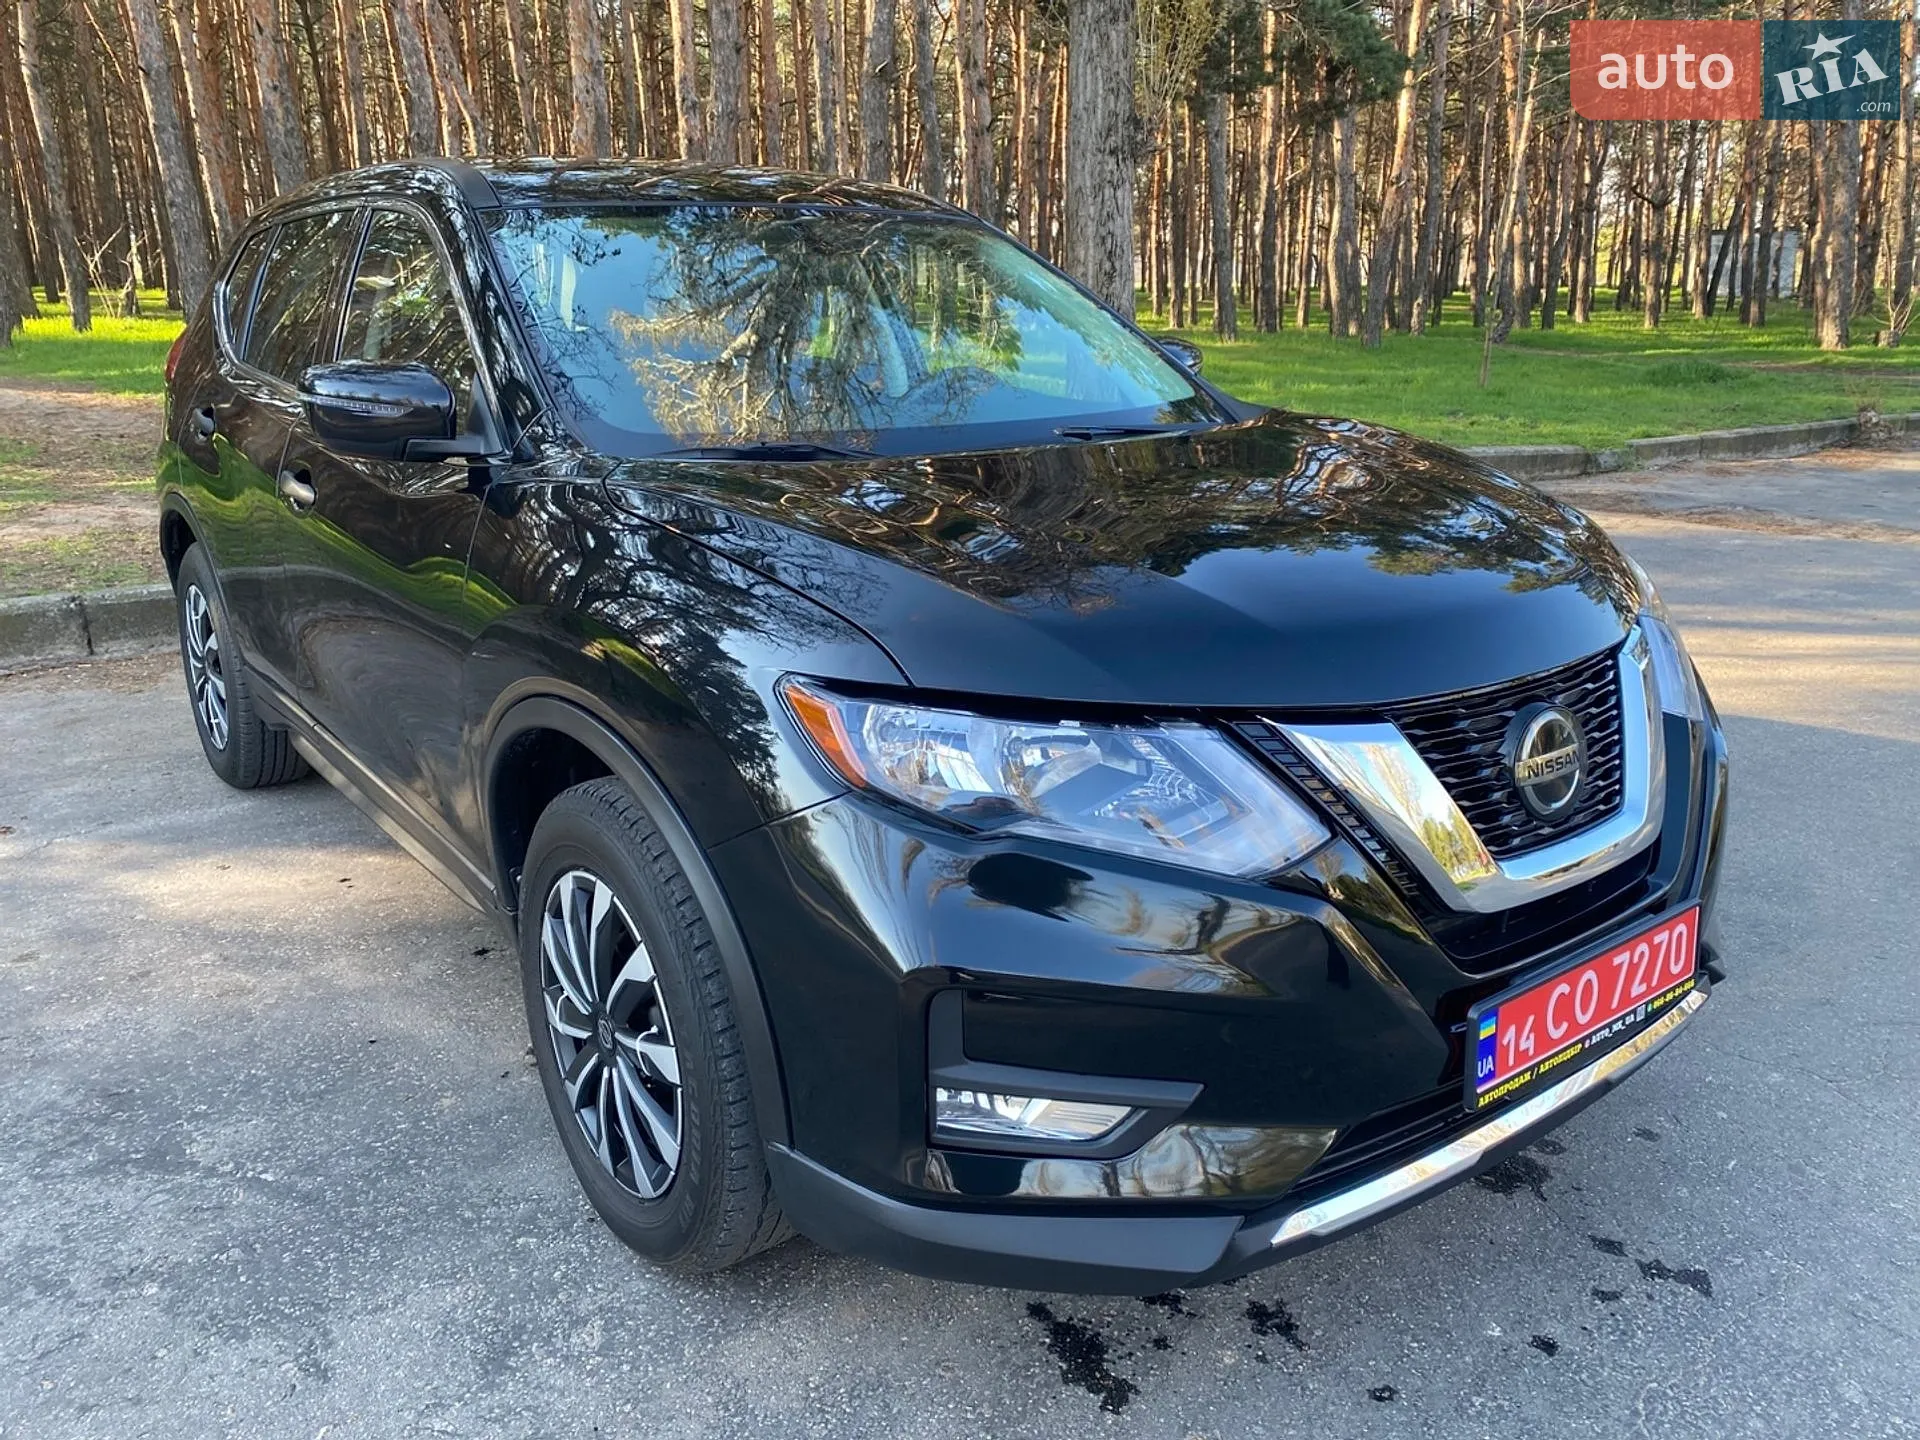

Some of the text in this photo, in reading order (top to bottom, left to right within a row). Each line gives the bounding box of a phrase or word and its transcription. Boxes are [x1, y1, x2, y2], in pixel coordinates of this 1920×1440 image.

[1527, 750, 1579, 779] NISSAN
[1502, 1013, 1536, 1066] 14
[1546, 969, 1599, 1039] CO
[1611, 923, 1688, 1009] 7270
[1477, 1057, 1494, 1078] UA
